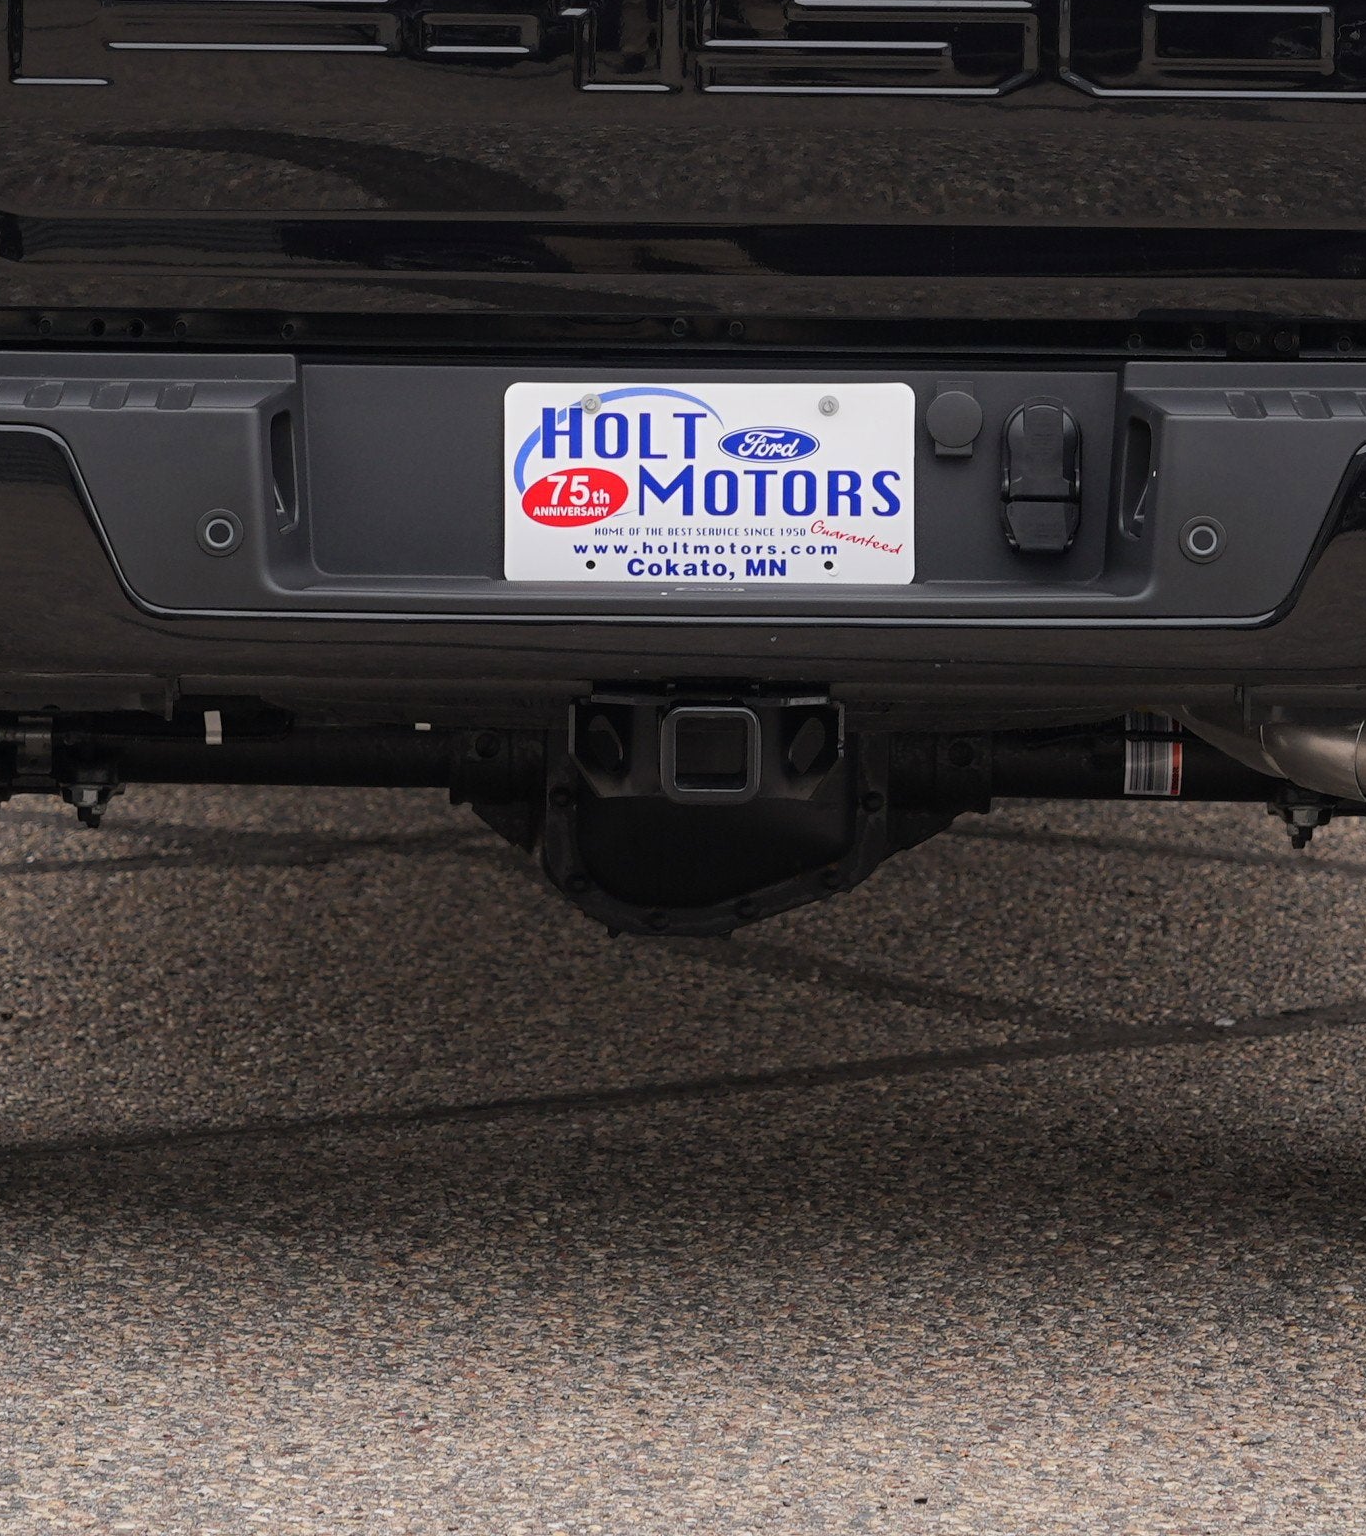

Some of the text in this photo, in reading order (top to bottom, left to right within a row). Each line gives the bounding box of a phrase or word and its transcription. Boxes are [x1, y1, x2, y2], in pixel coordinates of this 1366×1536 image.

[541, 407, 708, 459] HOLT
[737, 430, 800, 458] Ford
[546, 475, 610, 506] 75th
[638, 464, 902, 517] MOTORS
[532, 506, 610, 517] ANNIVERSARY
[594, 527, 807, 537] HOME OF THE BEST SERVICE SINCE 1950
[810, 519, 904, 556] Guaranteed
[572, 541, 838, 556] www.holtmotors.com
[626, 558, 787, 581] Cokato, MN
